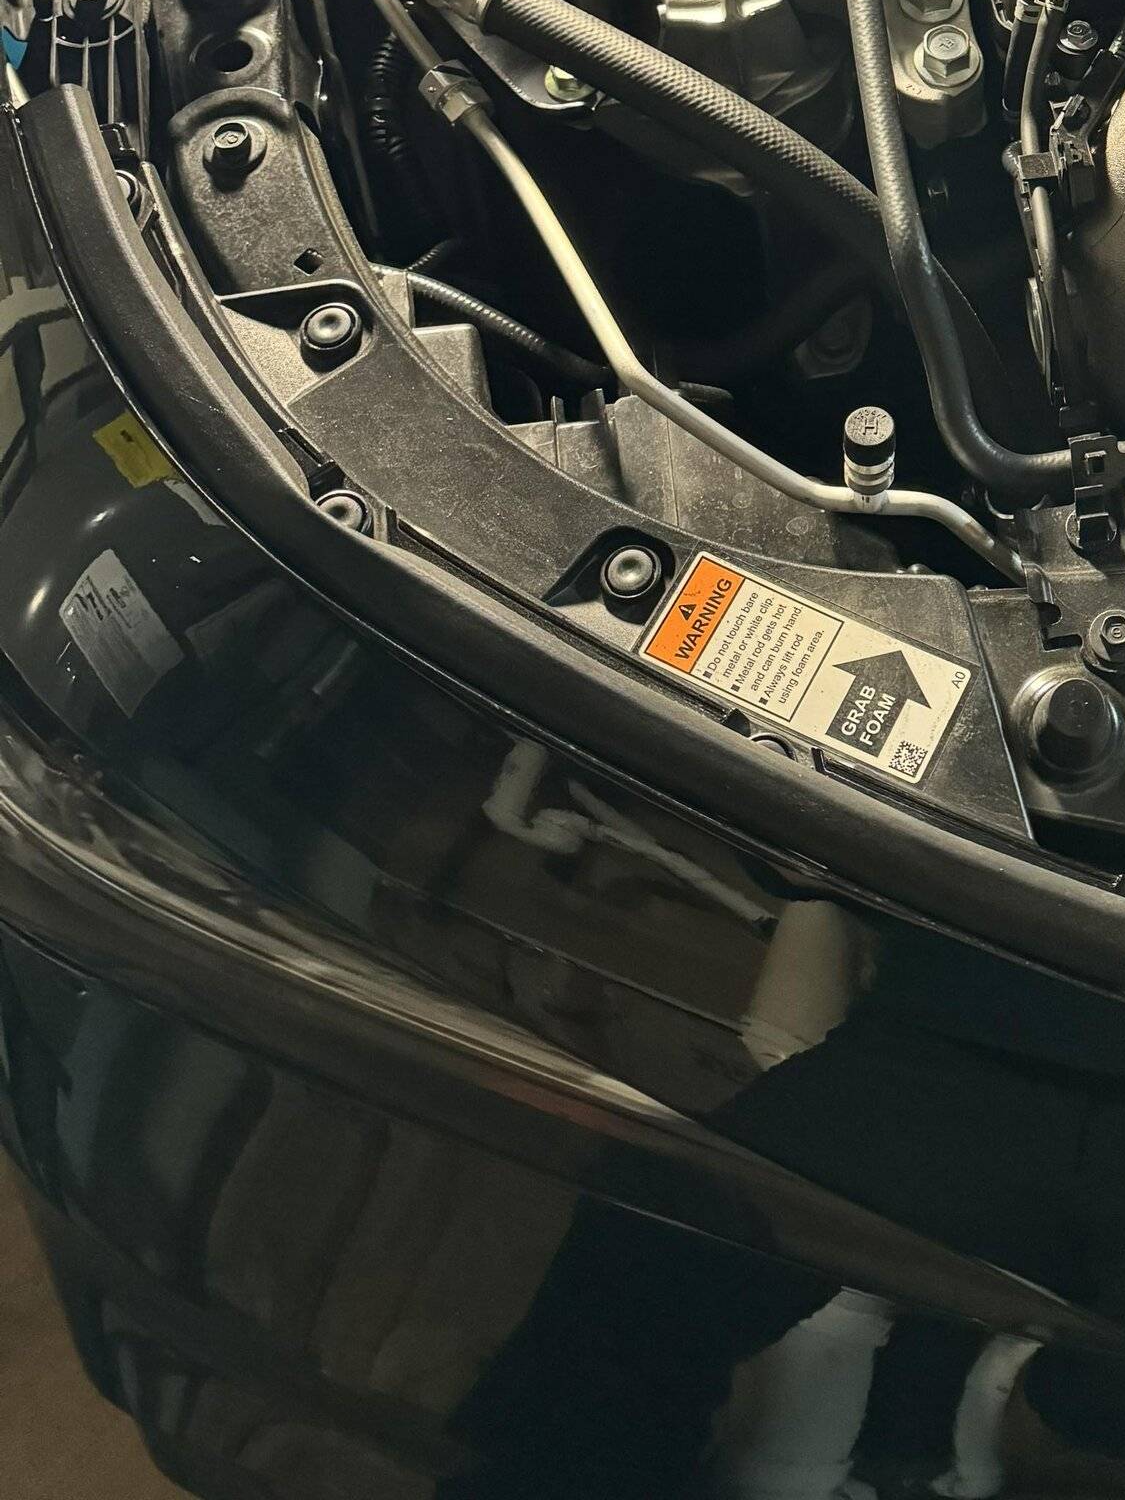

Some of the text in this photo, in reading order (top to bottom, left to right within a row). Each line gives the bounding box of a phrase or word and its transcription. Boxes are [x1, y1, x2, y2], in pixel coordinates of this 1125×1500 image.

[675, 578, 733, 661] WARNING
[707, 591, 760, 673] Do not touch bare
[722, 596, 776, 679] metal or white clip.
[735, 604, 788, 686] Metal rod gets hot
[750, 605, 804, 692] and can burn hand.
[766, 634, 805, 699] Always lift rod
[778, 629, 826, 705] using foam area.
[841, 685, 876, 736] GRAB
[859, 693, 896, 746] FOAM
